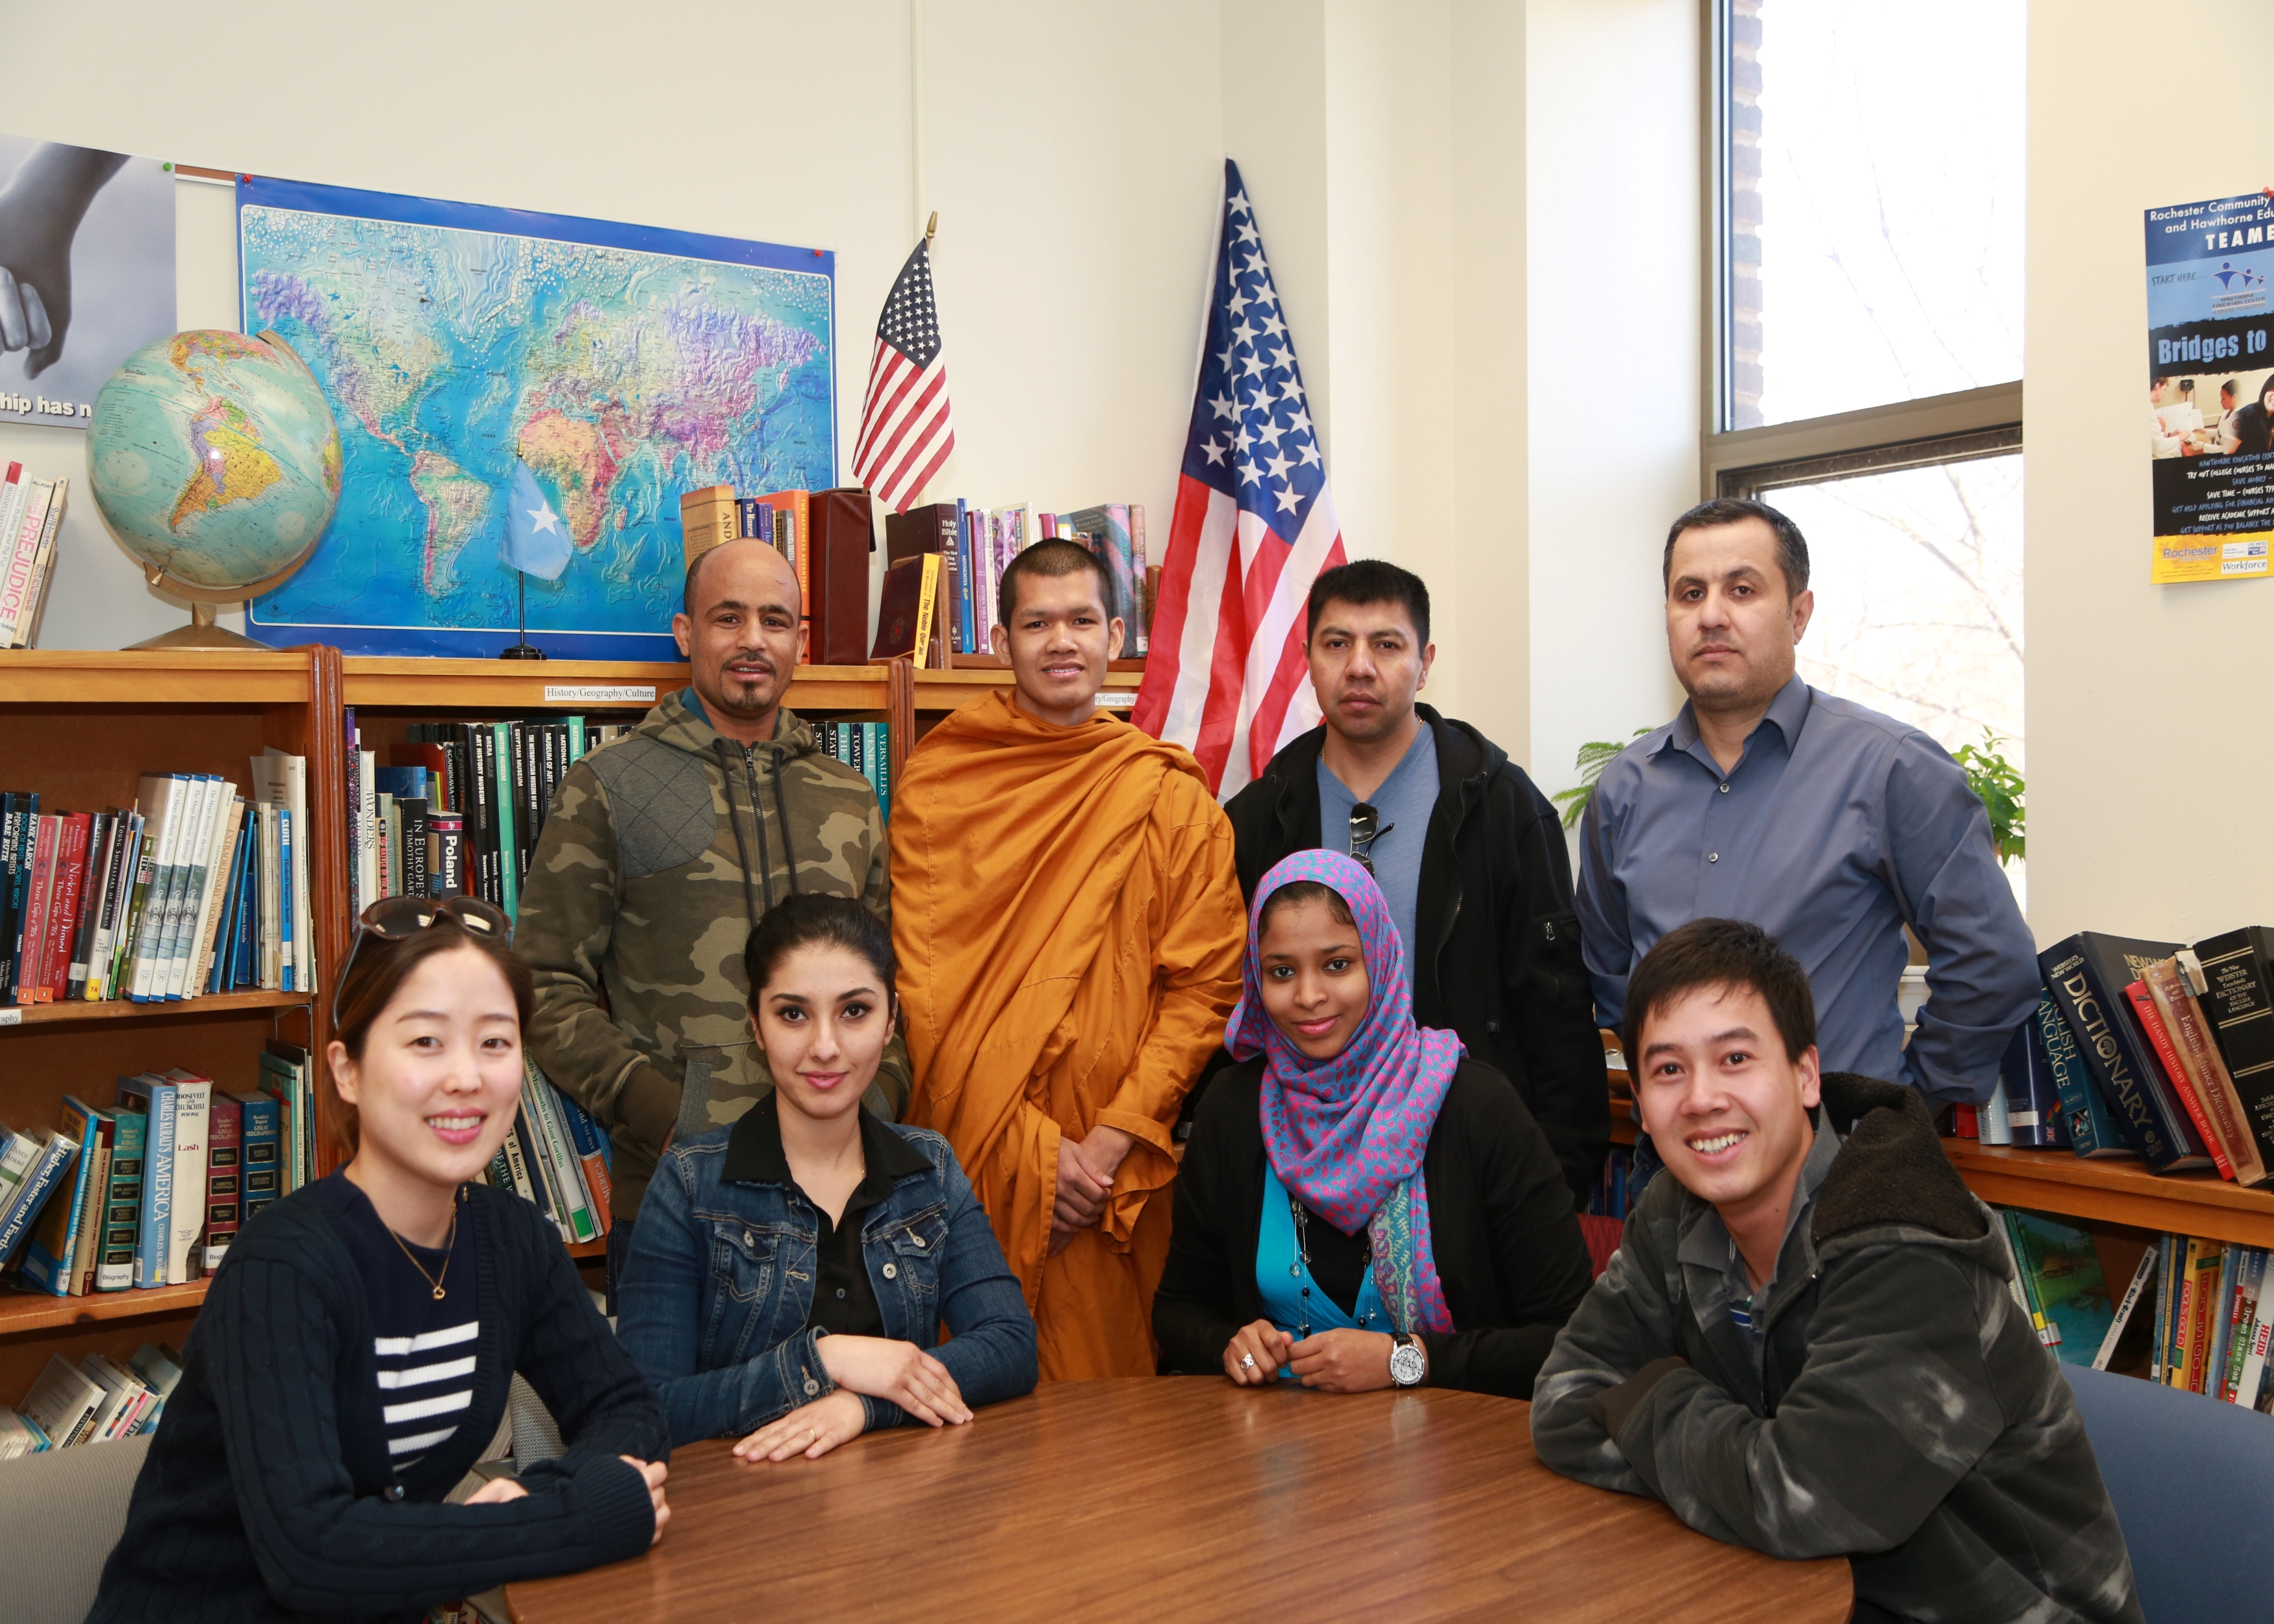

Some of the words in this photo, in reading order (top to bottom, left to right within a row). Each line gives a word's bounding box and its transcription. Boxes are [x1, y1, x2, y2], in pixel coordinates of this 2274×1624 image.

[2151, 205, 2204, 221] Rochester
[2209, 196, 2270, 213] Community
[2165, 222, 2186, 234] and
[2191, 214, 2253, 231] Hawthorne
[2257, 208, 2274, 220] Edu
[2153, 274, 2175, 286] START
[2221, 293, 2254, 302] HAWTHORNE
[2158, 334, 2238, 364] Bridges
[2247, 329, 2266, 353] to
[38, 396, 74, 415] has
[2199, 457, 2230, 467] HAWTHORNE
[2232, 454, 2260, 463] EDUCATION
[2210, 467, 2232, 477] COLLEGE
[2234, 464, 2255, 475] COURSES
[32, 481, 53, 489] ALLPORT
[2243, 486, 2263, 496] COURSES
[2184, 503, 2197, 512] HELP
[2199, 501, 2223, 511] APPLYING
[2237, 498, 2264, 507] FINANCIAL
[2199, 513, 2219, 522] RECEIVE
[2221, 511, 2245, 520] ACADEMIC
[2247, 508, 2269, 516] SUPPORT
[942, 520, 956, 528] Holy
[2192, 524, 2215, 533] SUPPORT
[2236, 520, 2258, 529] BALANCE
[2164, 546, 2217, 557] Rochester
[0, 514, 43, 621] PREJUDICE
[2223, 561, 2266, 570] Workforce
[547, 688, 654, 699] History/Geography/Culture
[546, 761, 552, 770] OF
[4, 813, 12, 837] BABE
[27, 813, 37, 839] HANK
[364, 789, 376, 850] WONDERS
[415, 819, 422, 833] IN
[10, 812, 21, 851] PERFORMING
[19, 833, 25, 842] OF
[117, 825, 125, 847] YOUNG
[1, 838, 10, 861] RUTH
[25, 841, 34, 870] AARON
[8, 852, 17, 875] ARTISTS
[110, 850, 121, 889] SUPERSTARS
[140, 857, 149, 871] TEN
[214, 830, 234, 899] EXTRAORDINARY
[446, 835, 457, 889] Poland
[34, 880, 44, 900] Three
[67, 863, 81, 896] Nickel
[32, 902, 41, 918] Cups
[104, 902, 112, 927] TENNIS
[205, 902, 218, 934] WOMEN
[59, 919, 73, 952] Dimed
[196, 937, 211, 980] SCIENTISTS
[2051, 967, 2065, 980] NEW
[2064, 957, 2084, 974] WORLD
[2216, 969, 2248, 983] WEBSTER
[2216, 981, 2256, 999] DICTIONARY
[2229, 996, 2251, 1007] ENGLISH
[2228, 1001, 2255, 1013] LANGUAGE
[2063, 971, 2153, 1128] DICTIONARY
[2144, 1006, 2156, 1021] THE
[2151, 1021, 2169, 1049] HANDY
[2165, 1050, 2186, 1084] HISTORY
[2182, 1085, 2203, 1119] ANSWER
[2197, 1119, 2215, 1145] BOOK
[2181, 1015, 2212, 1087] English-Khmer
[2210, 1087, 2236, 1137] Dictionary
[161, 1091, 175, 1121] CHARLES
[524, 1049, 533, 1072] Woolly
[531, 1074, 546, 1113] Mammoths
[546, 1121, 556, 1141] Giant
[552, 1140, 563, 1168] Gorillas
[159, 1122, 173, 1152] KURALT'S
[6, 1154, 25, 1167] ADAMS
[12, 1146, 29, 1159] JANUS
[511, 1150, 524, 1180] America
[154, 1154, 172, 1222] AMERICA
[2180, 1282, 2191, 1316] FOOL'S
[2232, 1293, 2242, 1319] SPINELLI
[2246, 1287, 2256, 1304] The
[2177, 1317, 2187, 1345] GOLD
[2242, 1305, 2252, 1334] Green
[2251, 1317, 2261, 1342] Johanna
[2235, 1334, 2246, 1361] Glass
[2247, 1342, 2256, 1356] Spyri
[2255, 1323, 2270, 1357] HEIDI
[2228, 1365, 2241, 1381] Sea
